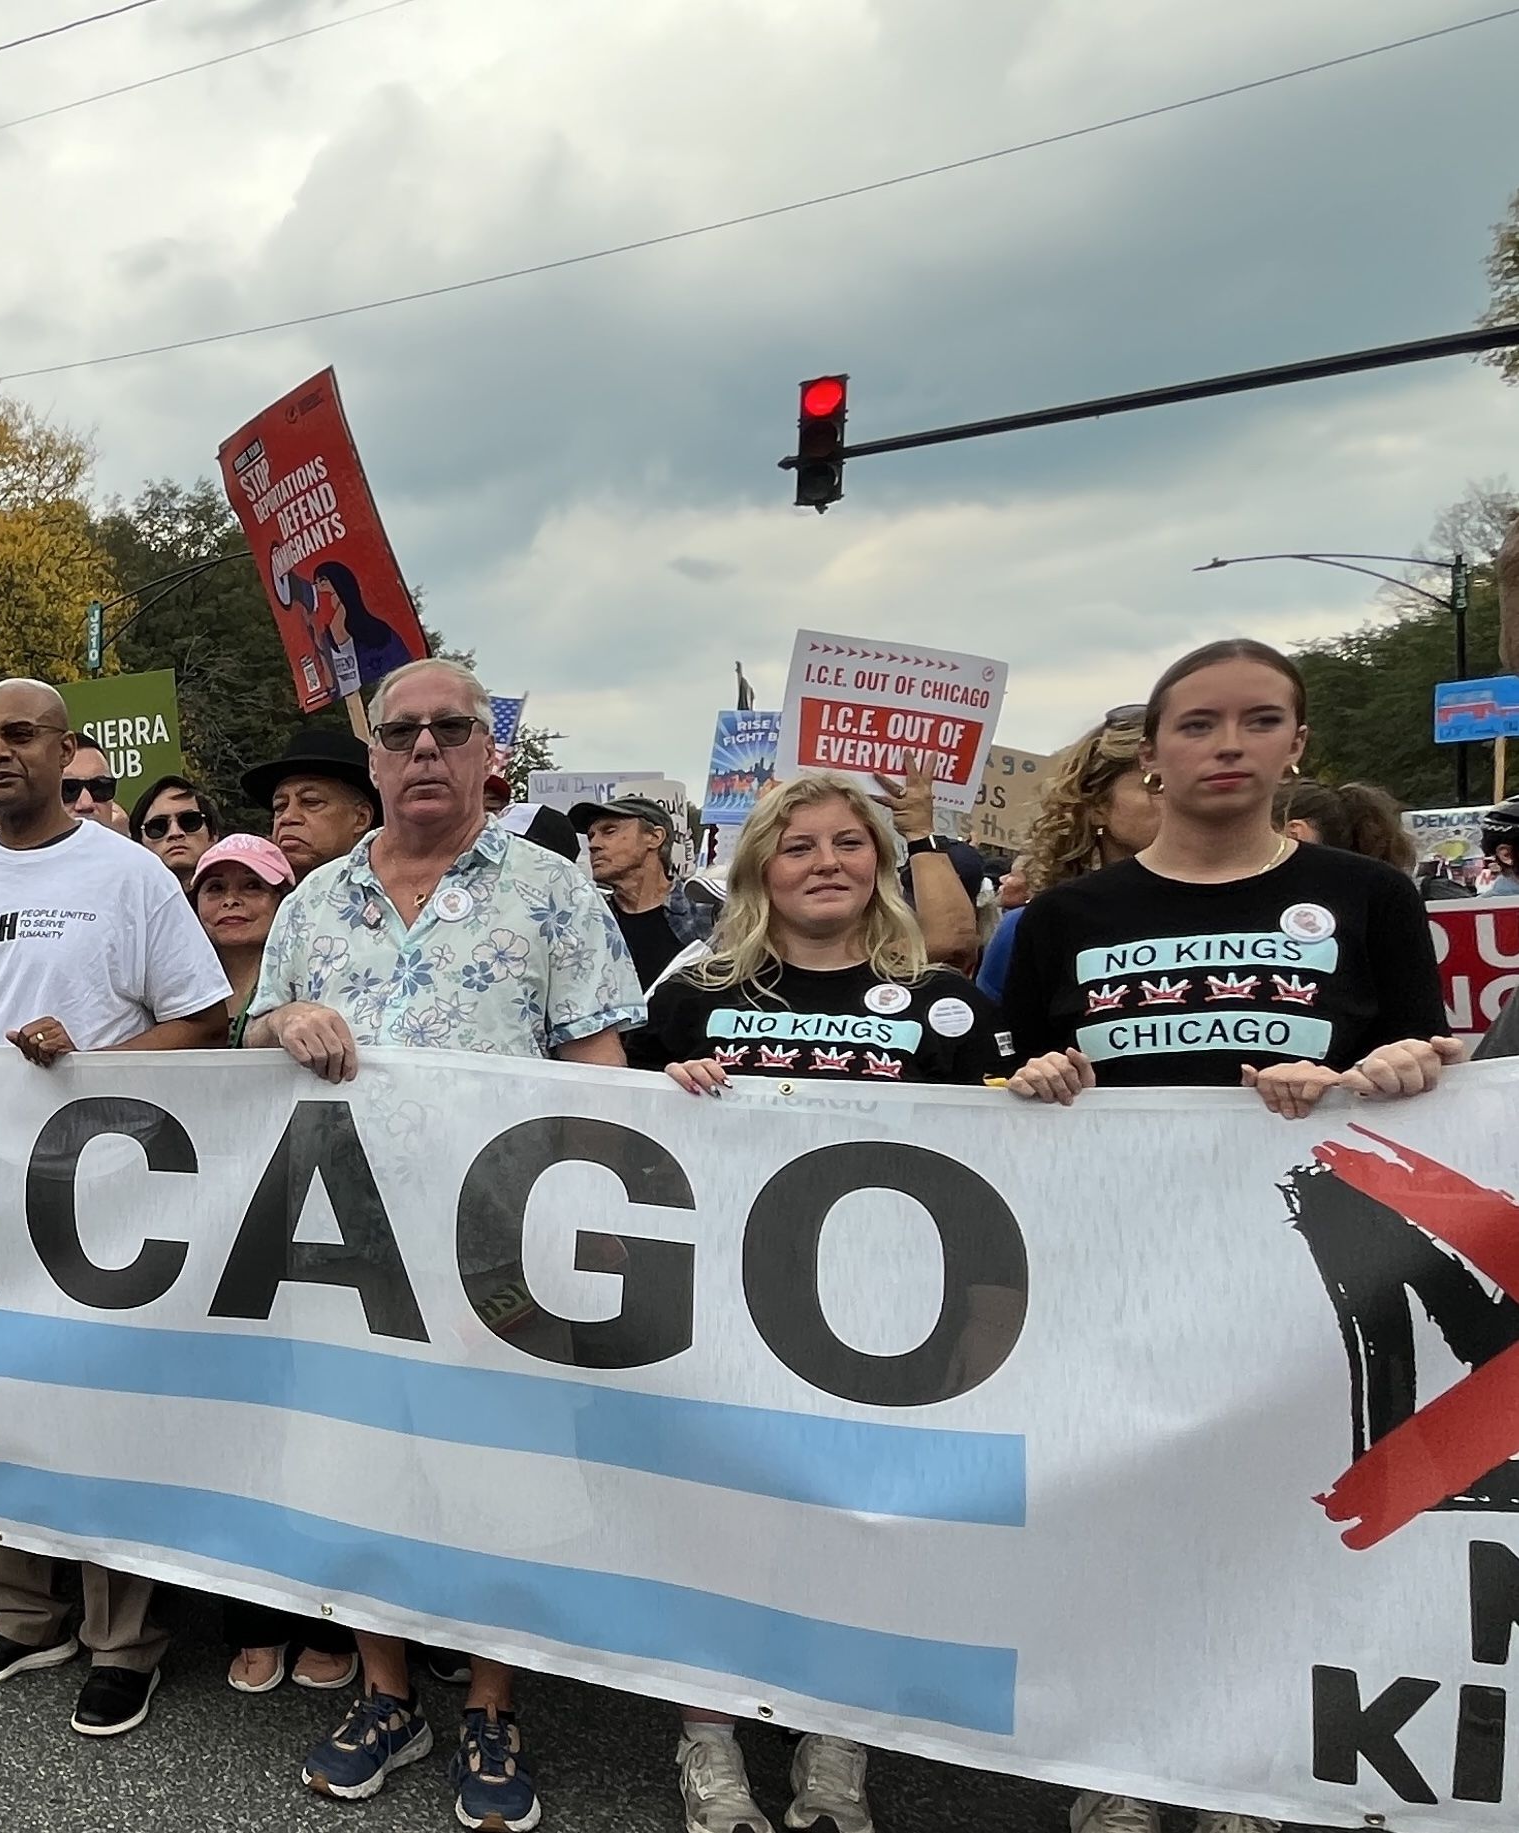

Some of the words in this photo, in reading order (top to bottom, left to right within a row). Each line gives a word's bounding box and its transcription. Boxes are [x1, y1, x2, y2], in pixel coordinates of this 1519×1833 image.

[239, 457, 271, 502] STOP
[252, 455, 328, 524] DEPORTATIONS
[276, 482, 337, 541] DEFEND
[805, 663, 847, 688] I.C.E.
[854, 670, 890, 691] OUT
[895, 674, 917, 696] OF
[921, 679, 990, 709] CHICAGO
[82, 714, 170, 749] SIERRA
[723, 732, 765, 747] FIGHT
[737, 719, 770, 731] RISE
[820, 704, 878, 737] I.C.E.
[887, 713, 935, 744] OUT
[939, 721, 966, 750] OF
[110, 749, 143, 779] UB
[1412, 811, 1481, 829] DEMOCR
[20, 909, 58, 919] PEOPLE
[60, 910, 97, 922] UNITED
[20, 919, 32, 928] TO
[33, 919, 66, 929] SERVE
[1105, 946, 1157, 973] NO
[1175, 938, 1303, 964] KINGS
[732, 1015, 778, 1035] NO
[790, 1017, 893, 1043] KINGS
[1108, 1018, 1291, 1051] CHICAGO
